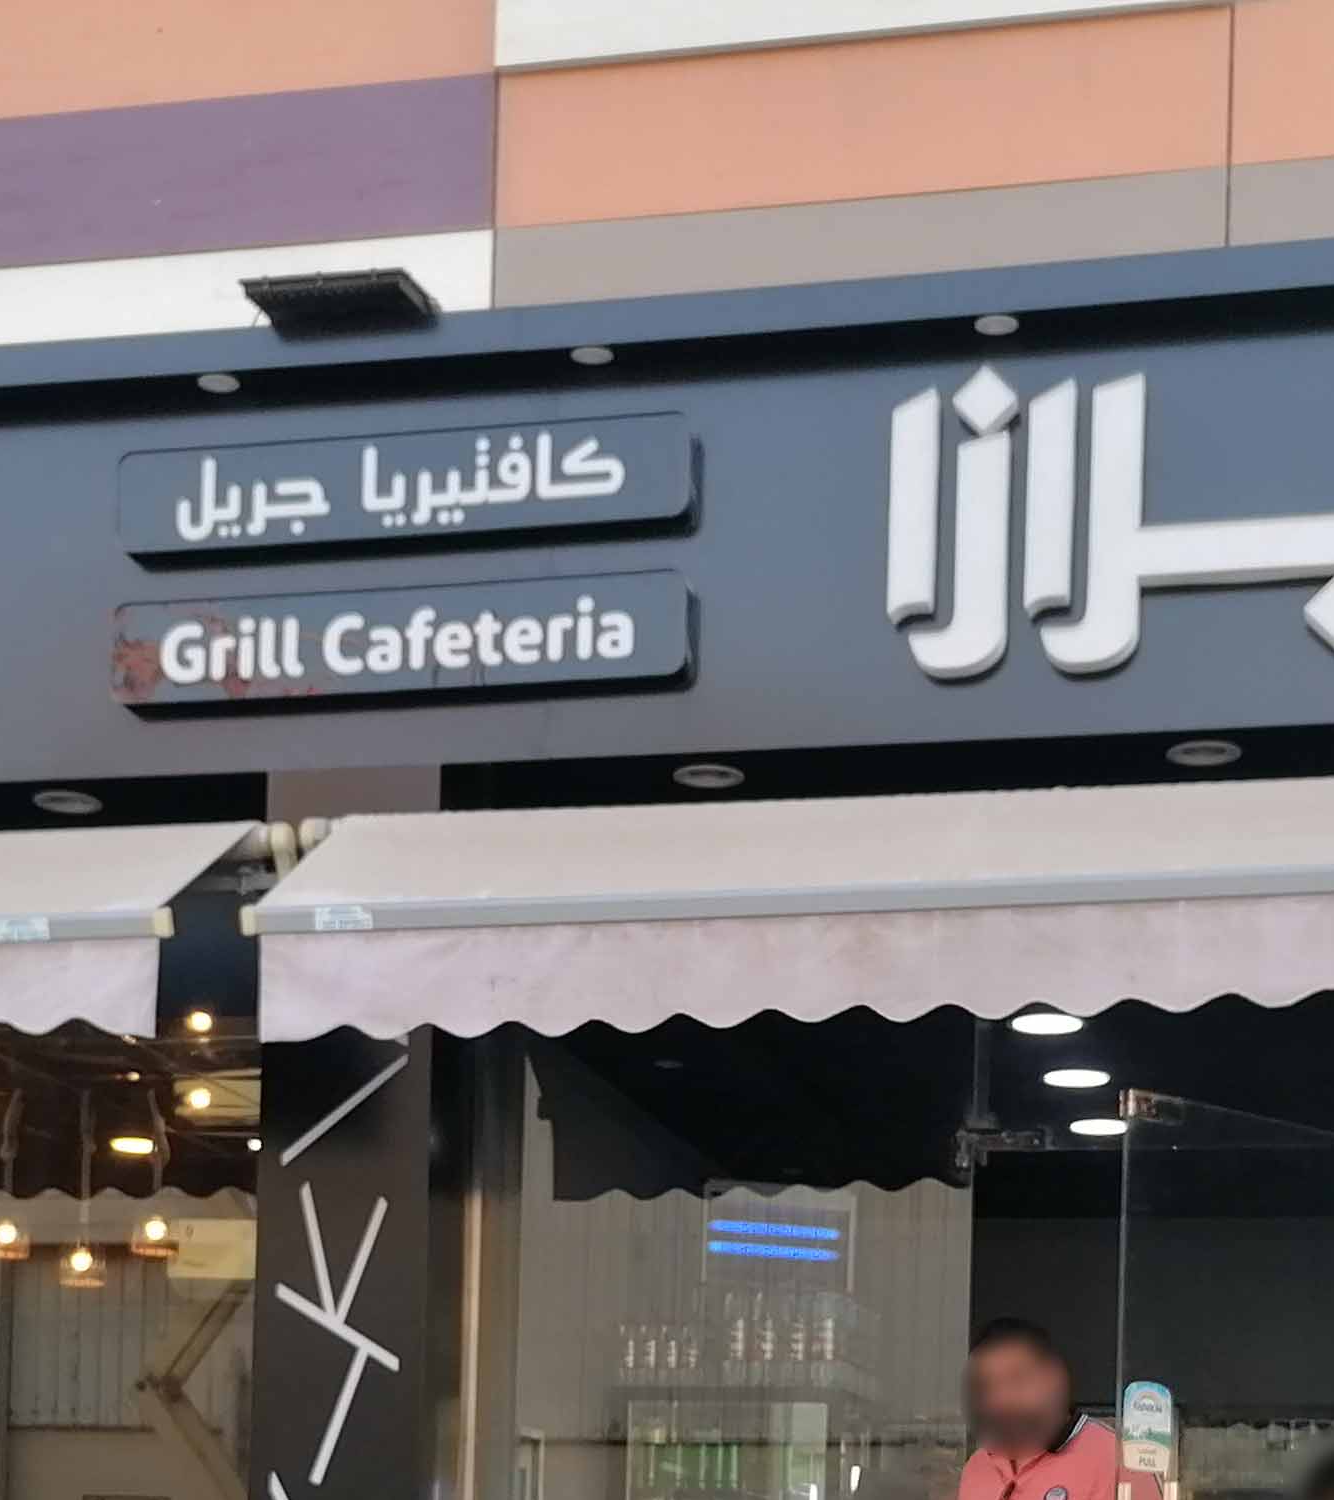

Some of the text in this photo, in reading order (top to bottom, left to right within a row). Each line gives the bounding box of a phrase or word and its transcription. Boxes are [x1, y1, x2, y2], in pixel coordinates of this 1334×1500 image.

[175, 432, 625, 541] كافتيريا جريل
[159, 595, 635, 684] Grill Cafeteria
